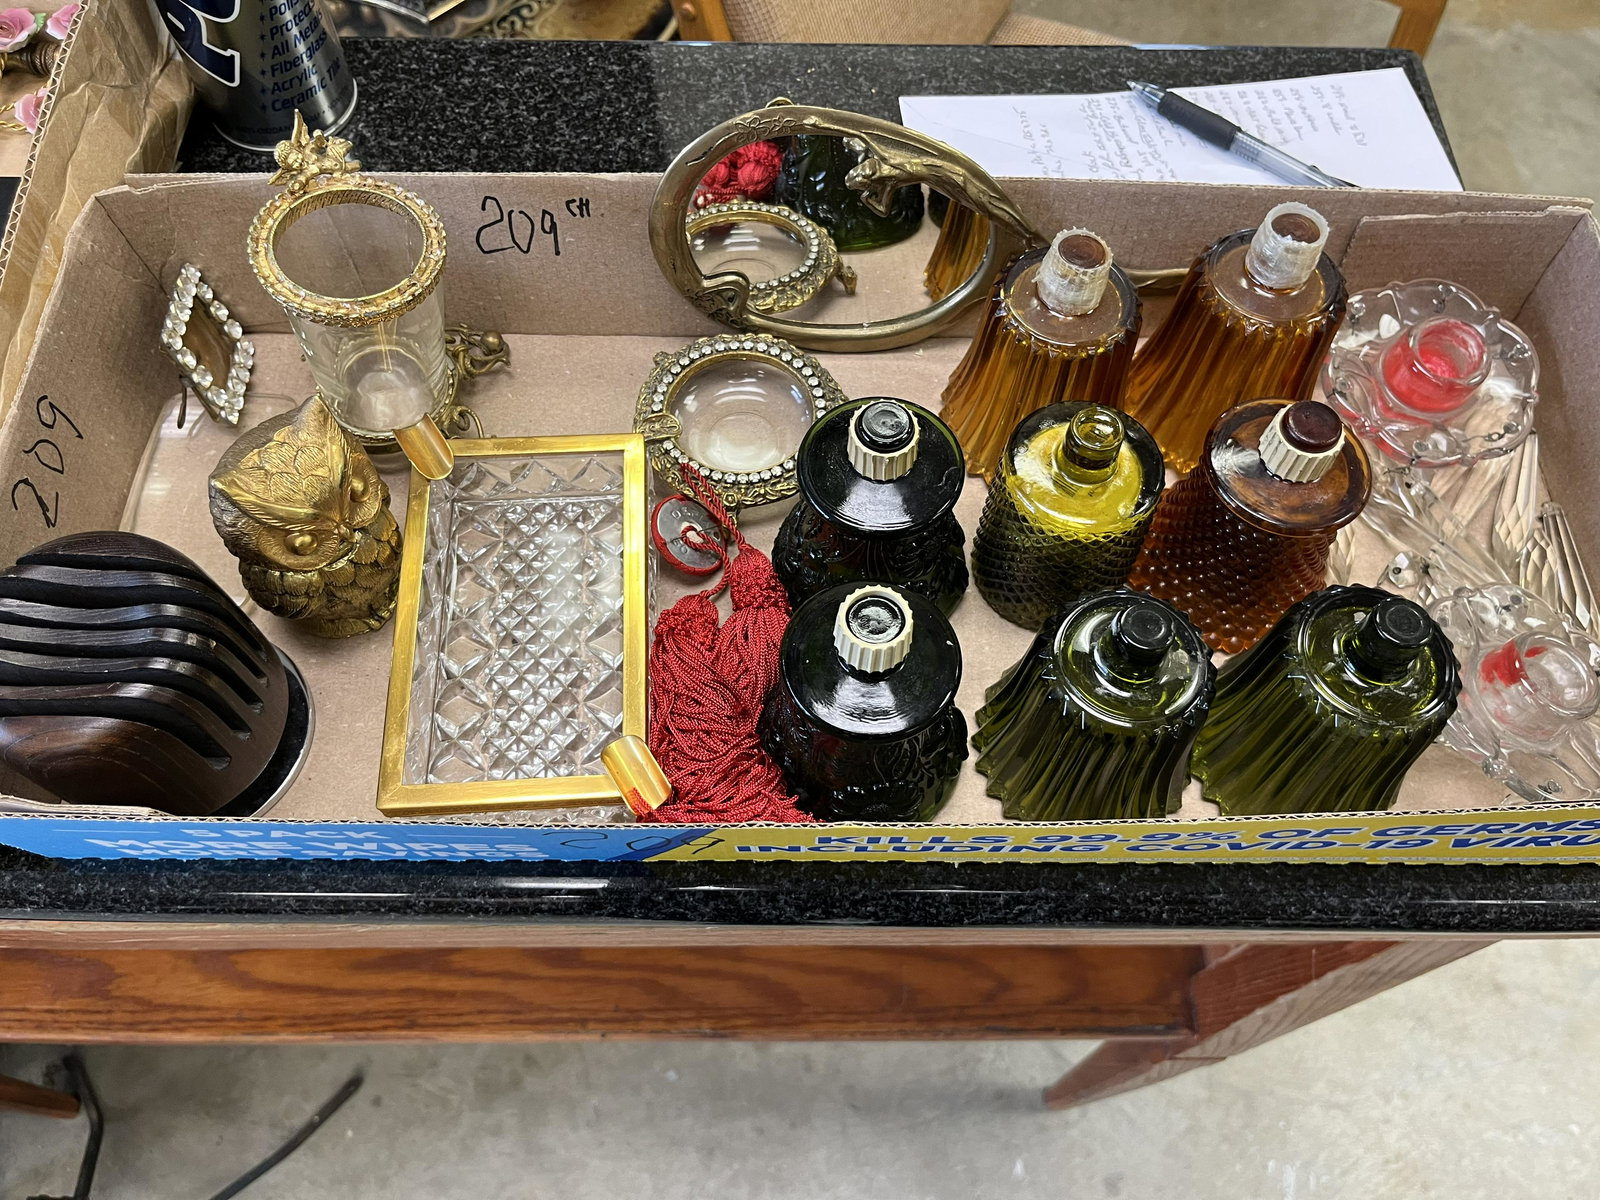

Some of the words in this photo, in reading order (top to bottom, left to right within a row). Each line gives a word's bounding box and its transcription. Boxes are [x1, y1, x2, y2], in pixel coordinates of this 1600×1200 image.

[270, 27, 328, 78] Fiberglass
[272, 40, 290, 59] All
[272, 64, 318, 95] Acrylic
[271, 77, 328, 112] Ceramic
[475, 195, 561, 256] 209
[11, 395, 84, 528] 209
[179, 829, 222, 838] 5
[224, 830, 392, 839] PACK
[543, 831, 725, 855] 209
[815, 835, 1015, 845] KILLS
[1030, 830, 1246, 844] 99.9%
[1256, 827, 1369, 839] OF
[1370, 819, 1600, 838] GERMS
[84, 838, 304, 849] MORE
[303, 841, 540, 852] WIPES
[116, 848, 291, 856] MORE
[300, 849, 550, 857] SAVINGS
[735, 844, 1110, 853] INCLUDING
[1124, 838, 1439, 852] COVID-19
